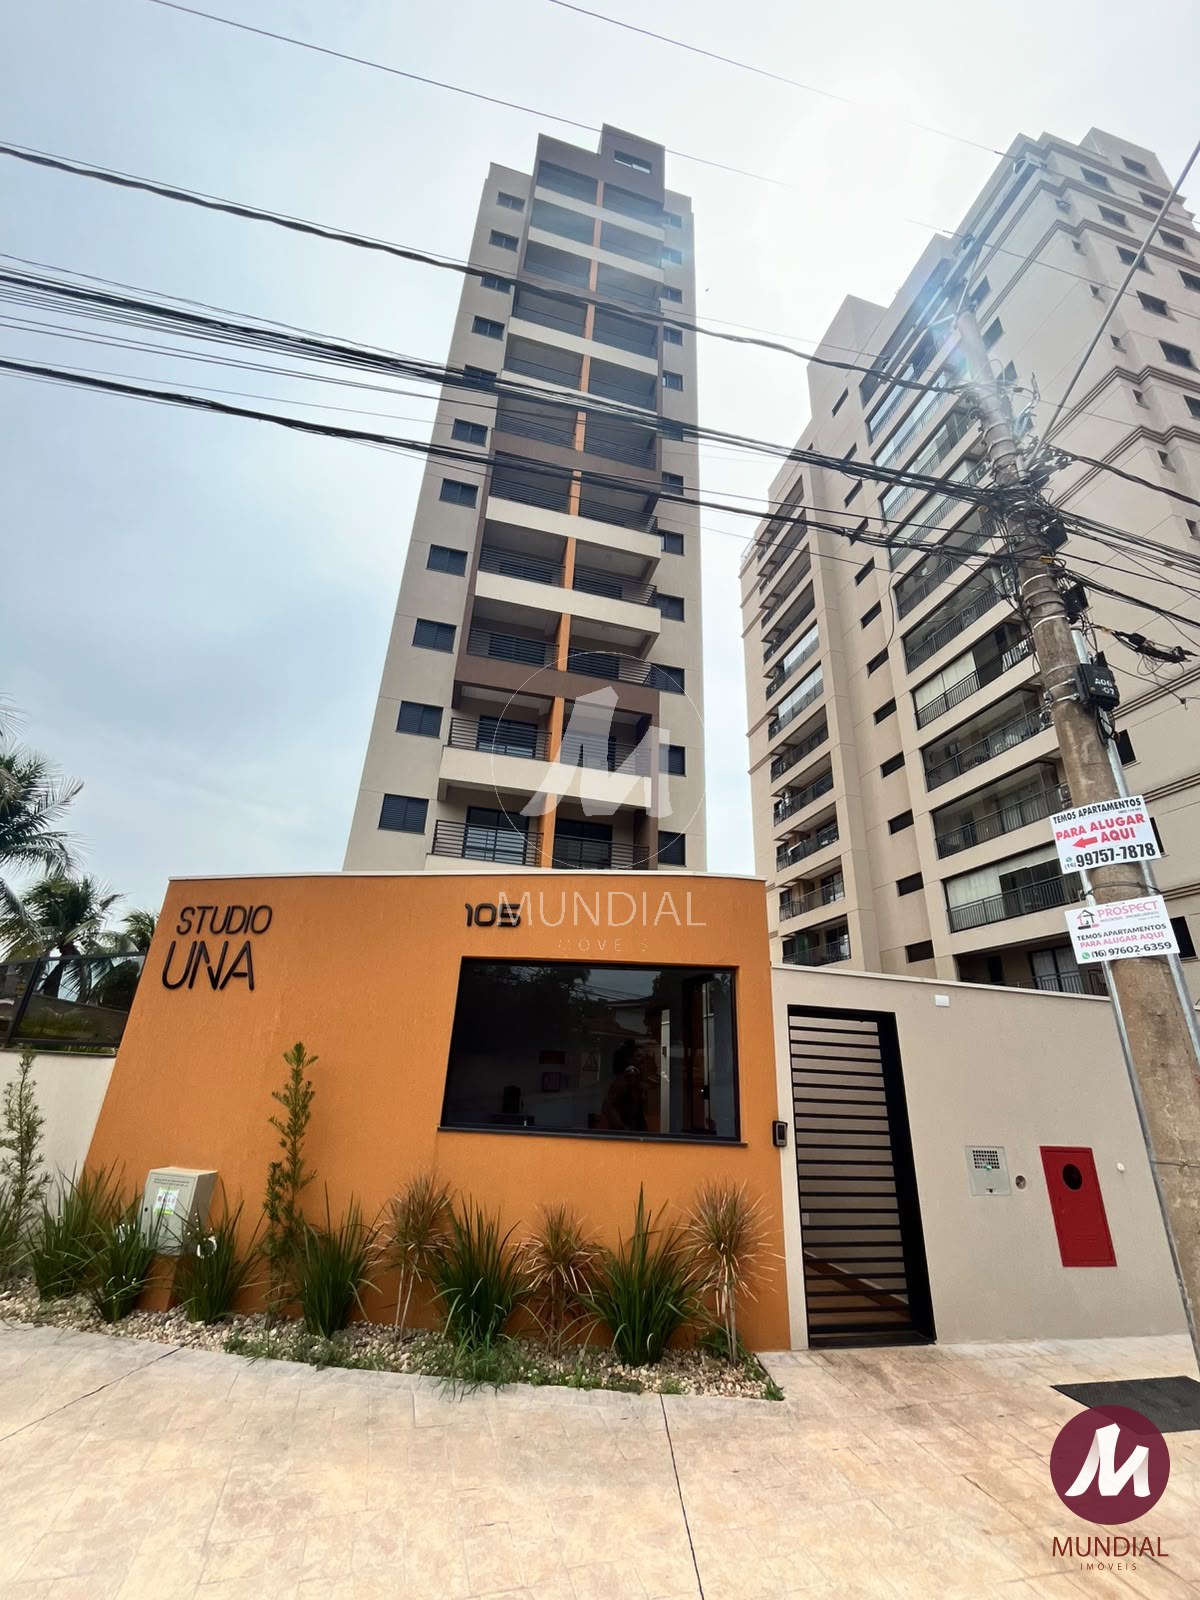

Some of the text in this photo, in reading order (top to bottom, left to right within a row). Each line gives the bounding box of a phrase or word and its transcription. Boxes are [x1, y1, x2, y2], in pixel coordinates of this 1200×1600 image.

[1053, 811, 1077, 824] TEMOS
[1078, 798, 1142, 818] APARTAMENTOS
[1055, 813, 1146, 841] PARA ALUGAR
[1100, 827, 1136, 843] AQUI
[1075, 842, 1156, 868] 99757-7878
[176, 905, 273, 935] STUDIO
[464, 903, 522, 928] 105
[1096, 900, 1159, 918] PROSPECT
[1077, 932, 1103, 941] TEMOS
[1103, 922, 1167, 937] APARTAMENTOS
[1080, 931, 1165, 949] PARA ALUGAR AQUI
[1091, 941, 1173, 958] (16) 97602-6359
[162, 940, 255, 991] UNA
